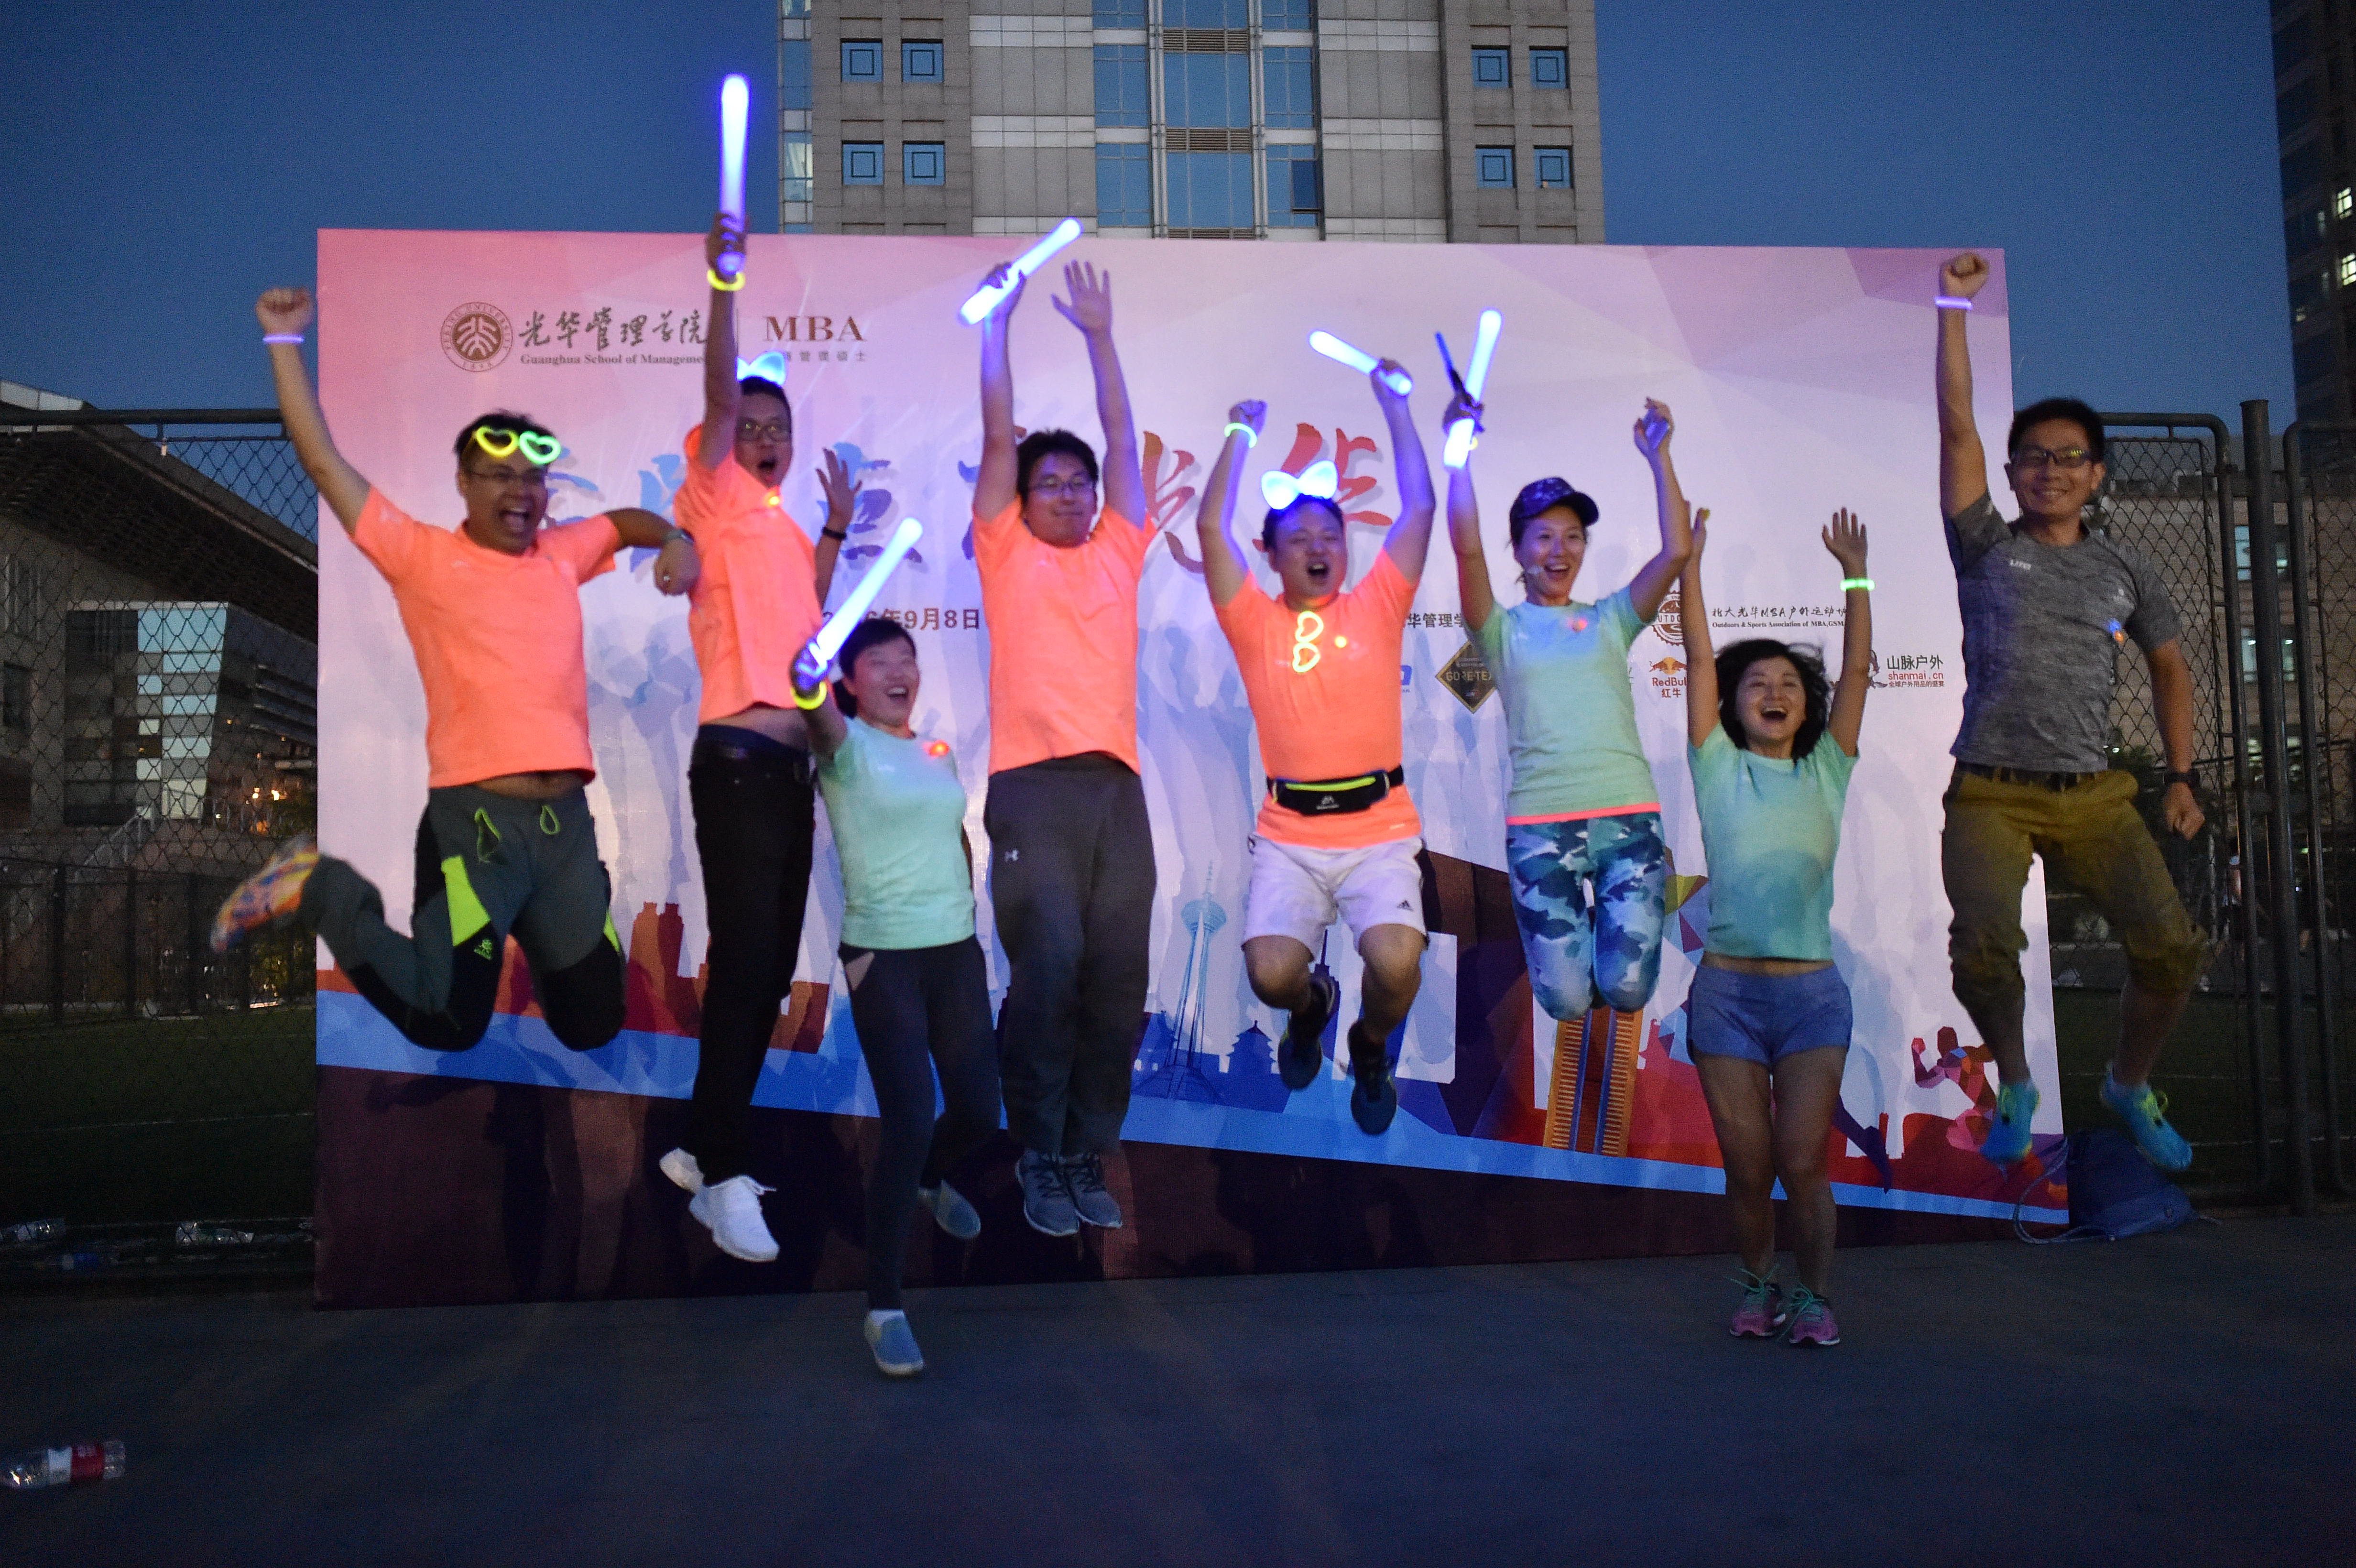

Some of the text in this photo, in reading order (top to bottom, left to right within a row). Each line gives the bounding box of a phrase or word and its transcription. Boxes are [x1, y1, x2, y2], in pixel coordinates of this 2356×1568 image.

[763, 316, 867, 342] MBA
[521, 354, 703, 366] Guanghua School of Manageme
[1887, 654, 1943, 670] 山脉户外
[1652, 677, 1687, 686] RedBul
[1661, 688, 1681, 698] 红牛
